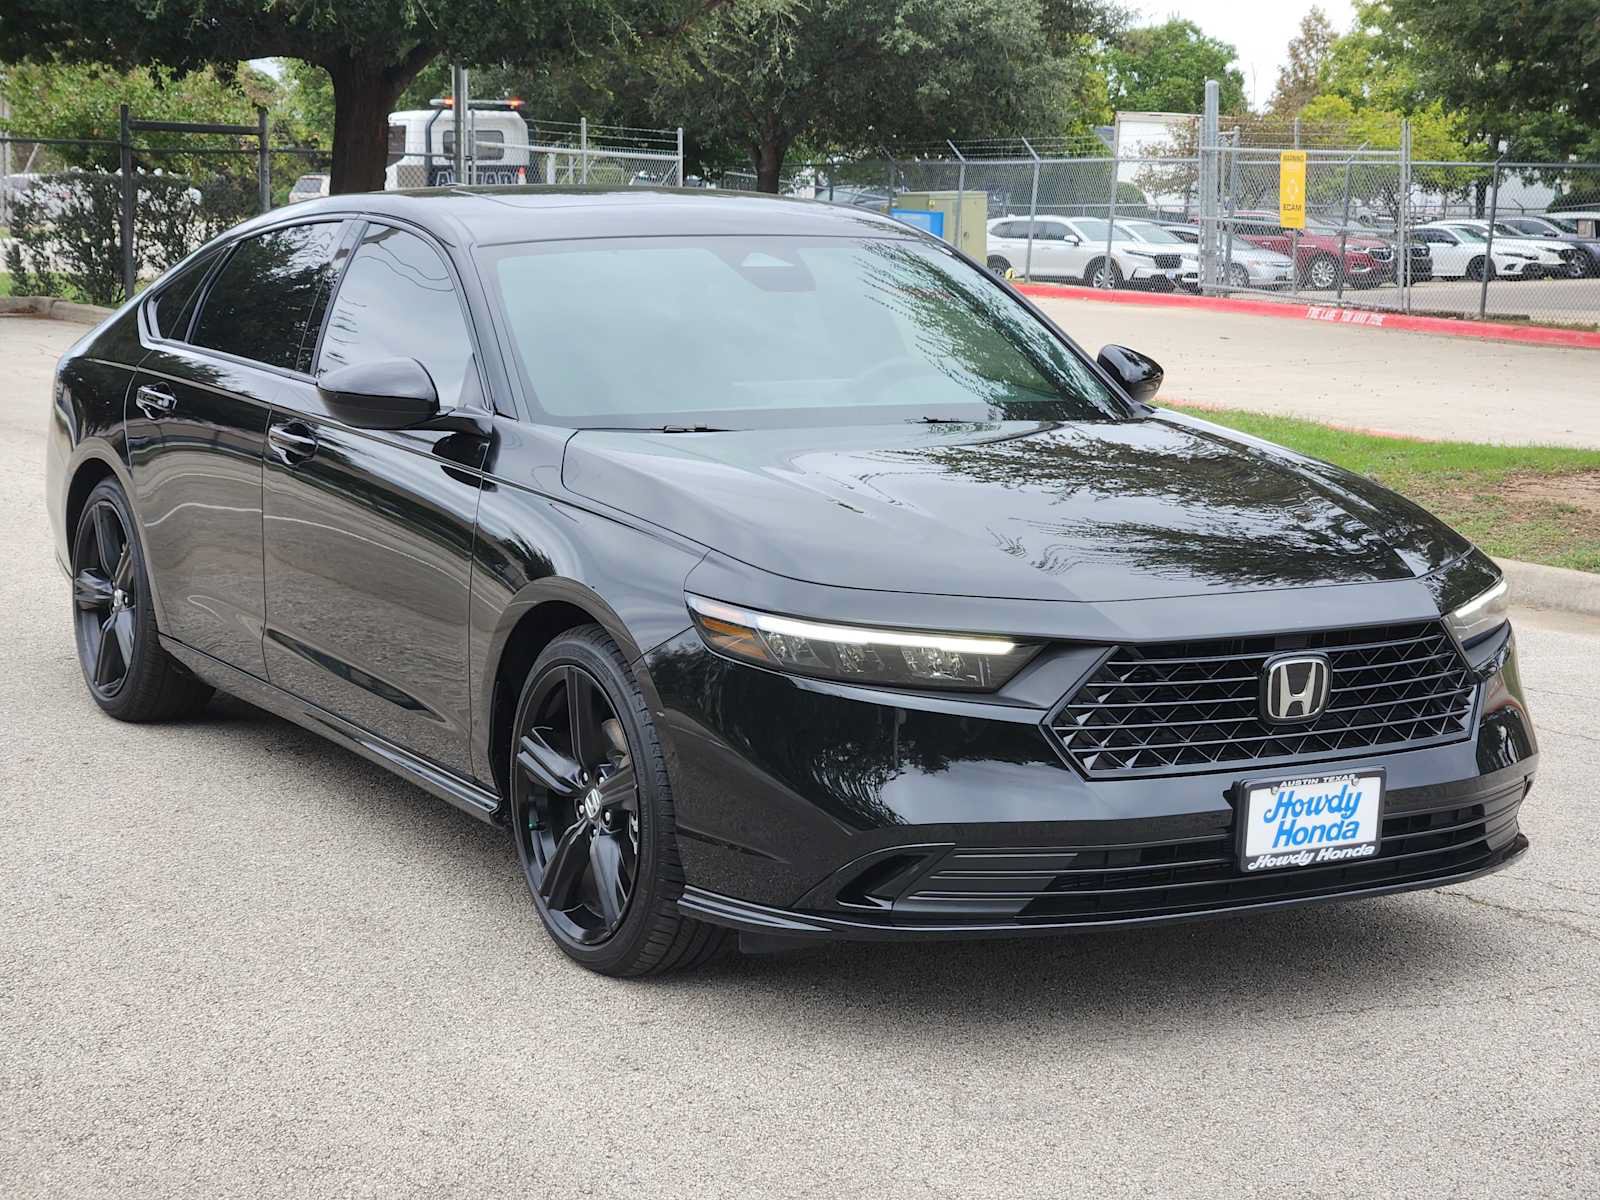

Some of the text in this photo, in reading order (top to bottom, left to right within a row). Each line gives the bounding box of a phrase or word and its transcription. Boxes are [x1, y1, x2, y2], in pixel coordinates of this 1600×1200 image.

[1280, 774, 1355, 788] AUSTIN TEXAS
[1263, 784, 1362, 824] Howdy
[1272, 819, 1360, 849] Honda
[1247, 844, 1375, 870] Howdy Honda
